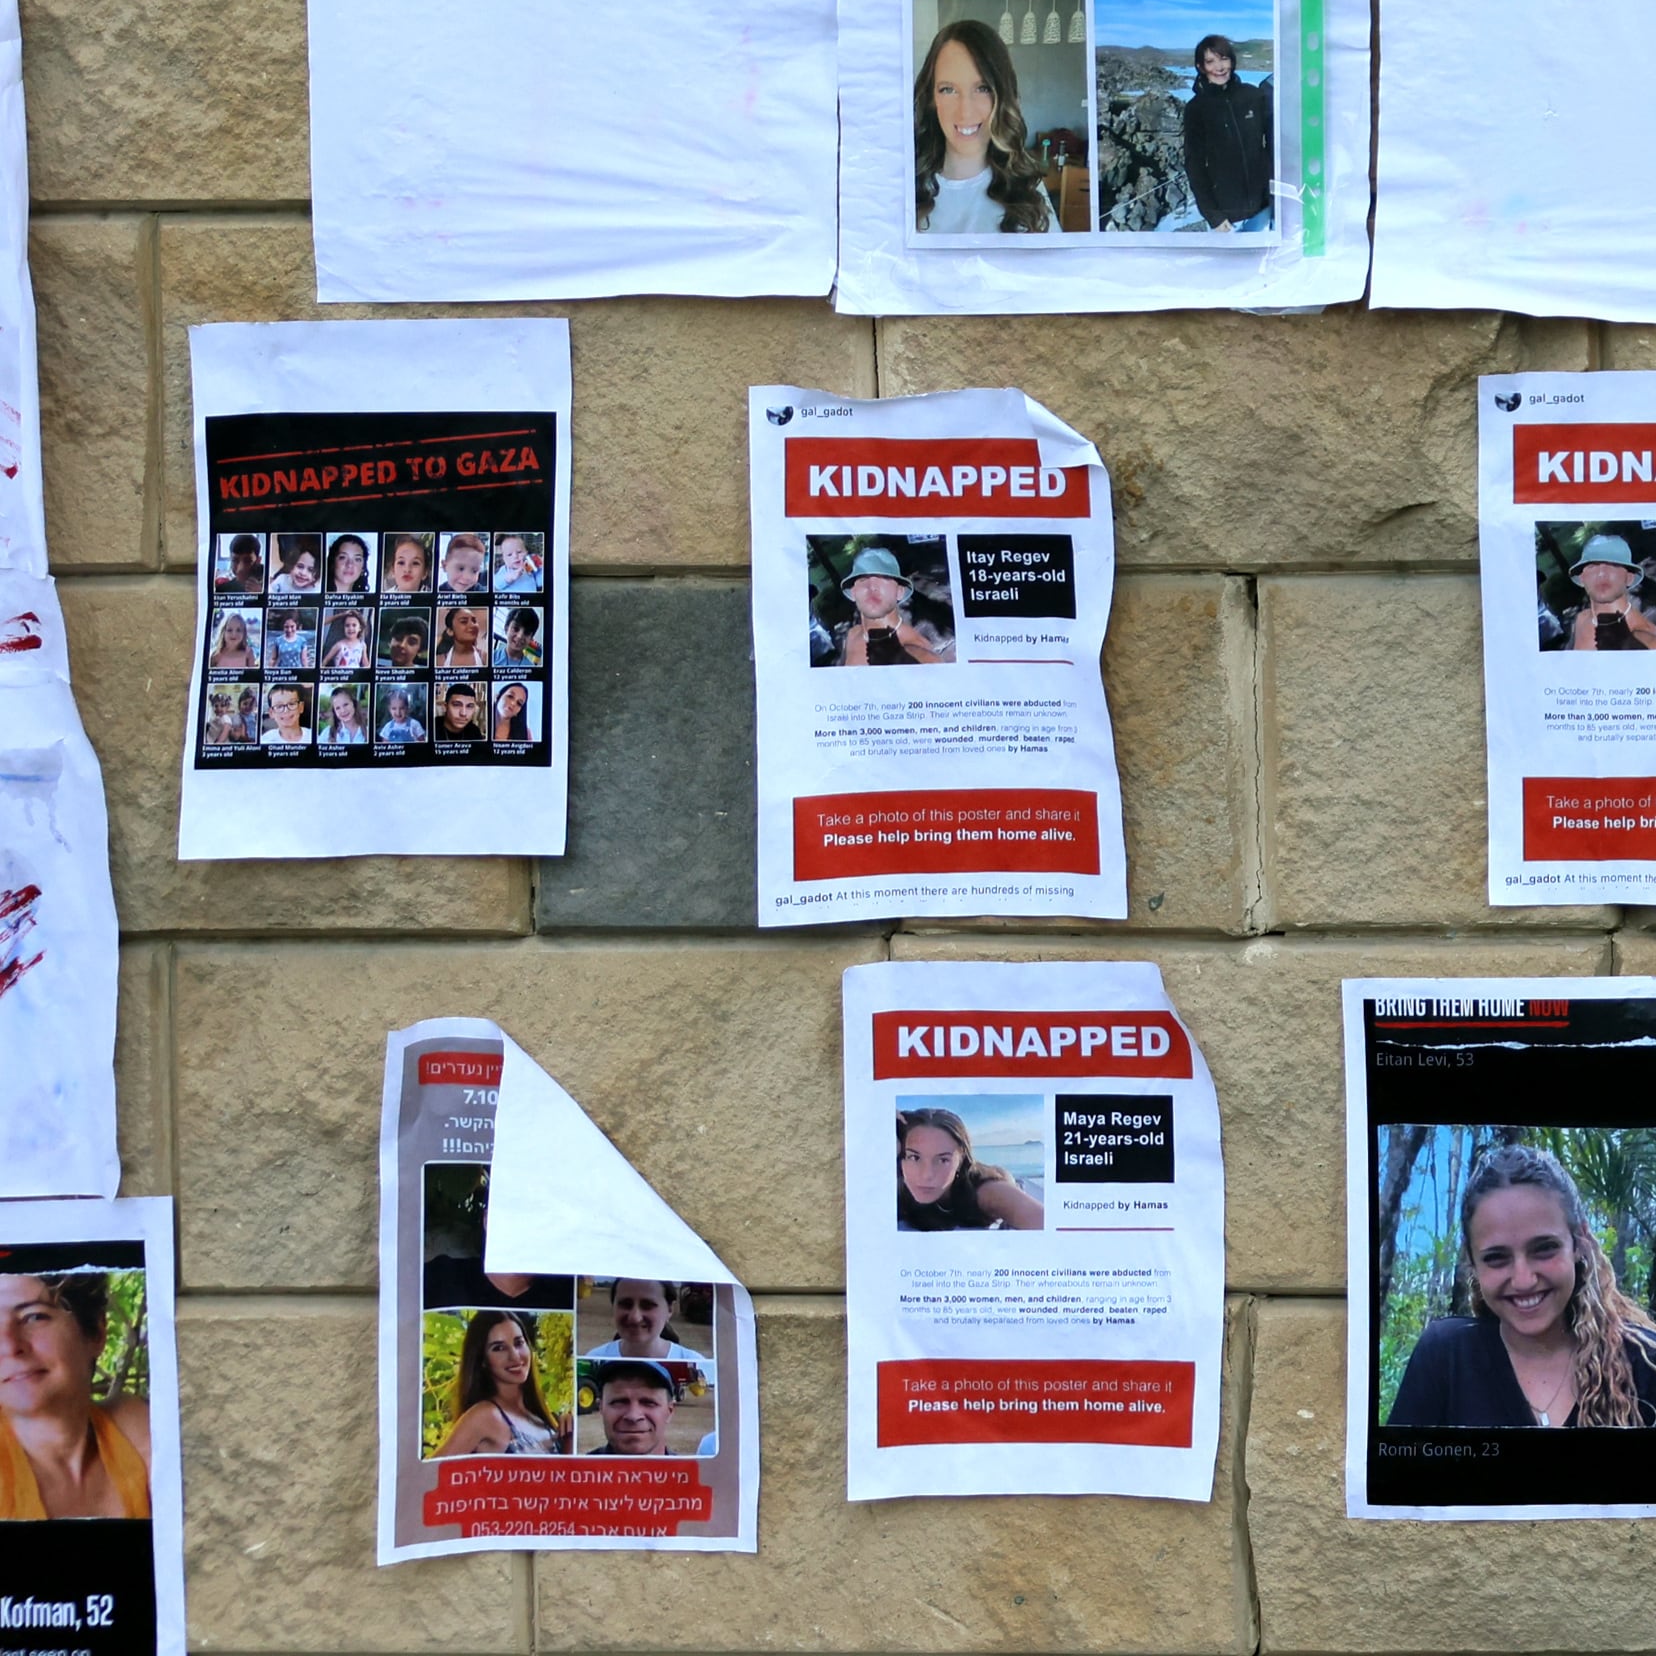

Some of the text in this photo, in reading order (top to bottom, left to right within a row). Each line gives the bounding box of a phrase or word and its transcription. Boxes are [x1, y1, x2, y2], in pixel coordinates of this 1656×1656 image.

[1529, 393, 1584, 405] gal_gadot
[801, 406, 853, 418] gal_gadot
[219, 446, 541, 499] KIDNAPPED TO GAZA
[809, 462, 1070, 497] KIDNAPPED
[967, 550, 1050, 566] Itay Regev
[969, 569, 1066, 585] 18-years-old
[970, 587, 1019, 601] Israeli
[824, 827, 1075, 847] Please help bring them home alive.
[898, 1026, 1170, 1057] KIDNAPPED
[1376, 1052, 1474, 1068] Eitan Levi, 53
[1064, 1111, 1161, 1129] Maya Regev
[1064, 1131, 1164, 1148] 21-years-old
[1065, 1151, 1113, 1165] Israeli
[1063, 1199, 1168, 1212] Kidnapped by Hamas
[994, 1269, 1009, 1277] 200
[1011, 1269, 1049, 1277] innocent
[1051, 1268, 1087, 1277] civilians
[1112, 1269, 1152, 1277] abducted
[1378, 1442, 1500, 1458] Romi Gonen, 23
[0, 1594, 114, 1633] Kofman, 52
